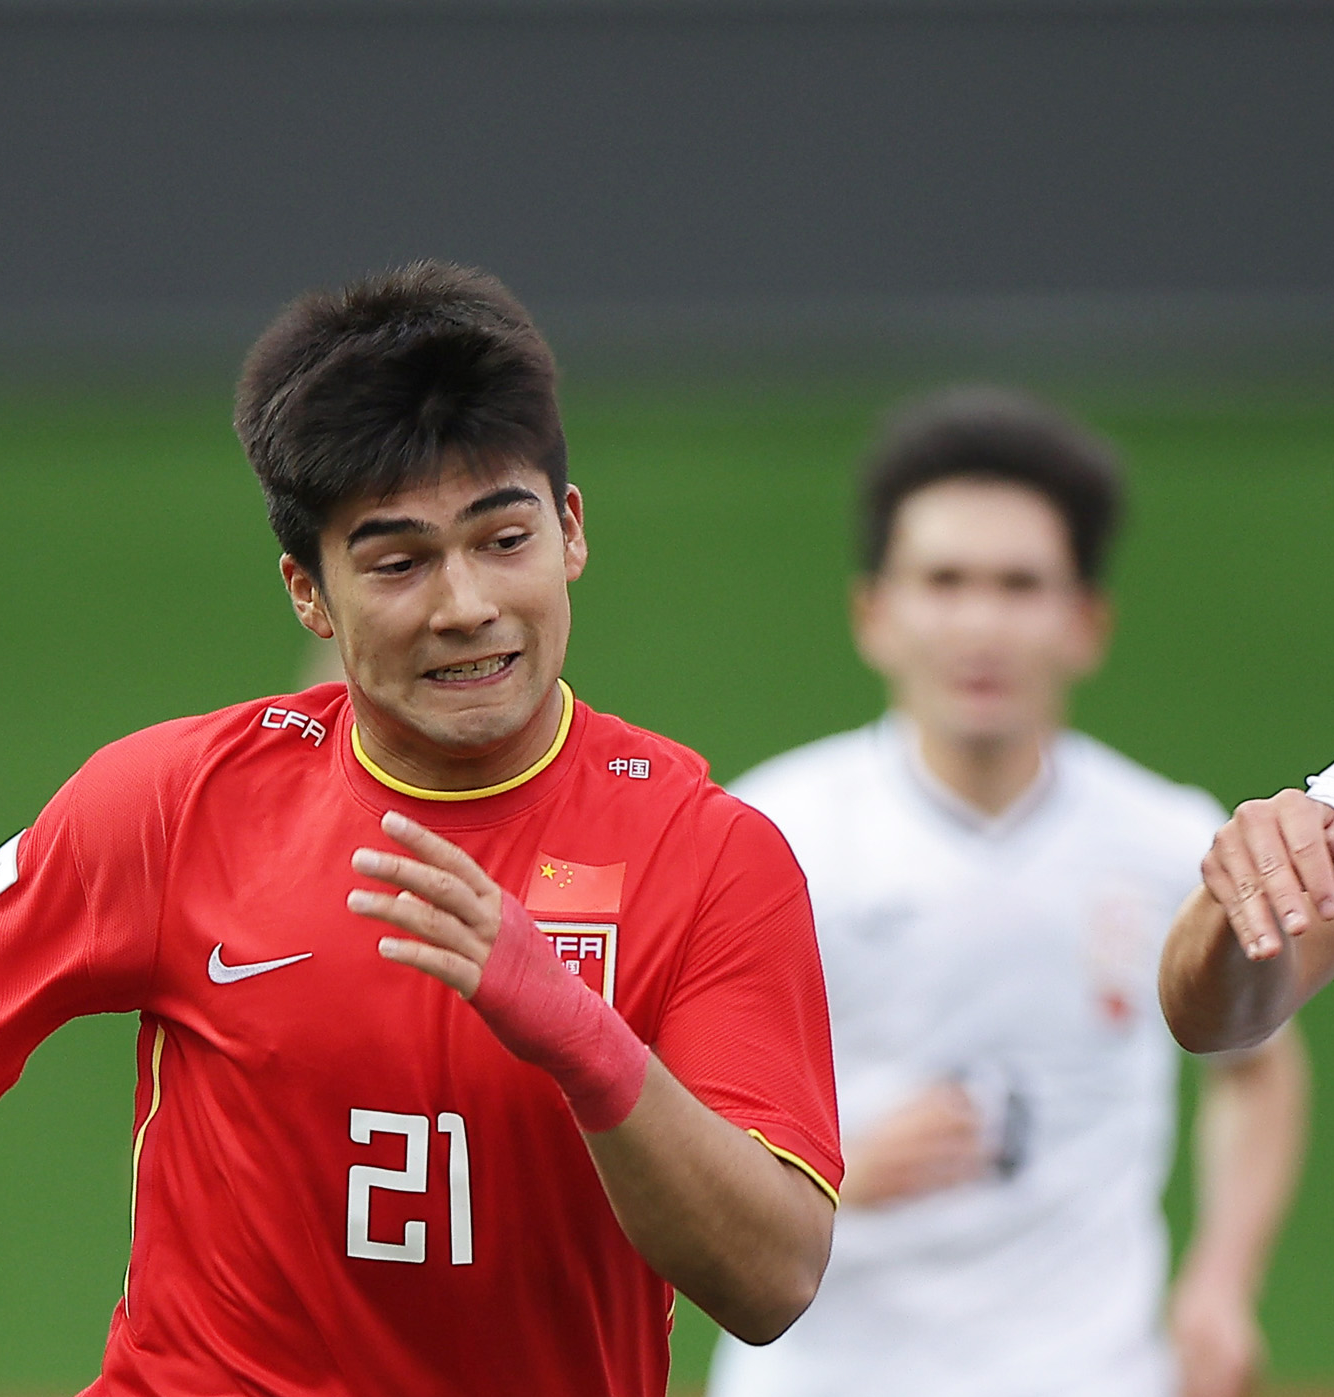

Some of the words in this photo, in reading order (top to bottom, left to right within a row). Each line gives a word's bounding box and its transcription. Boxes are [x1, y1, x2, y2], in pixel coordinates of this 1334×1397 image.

[261, 706, 327, 748] CFA
[608, 757, 650, 779] 中国
[547, 936, 603, 959] FA
[347, 1108, 473, 1265] 21
